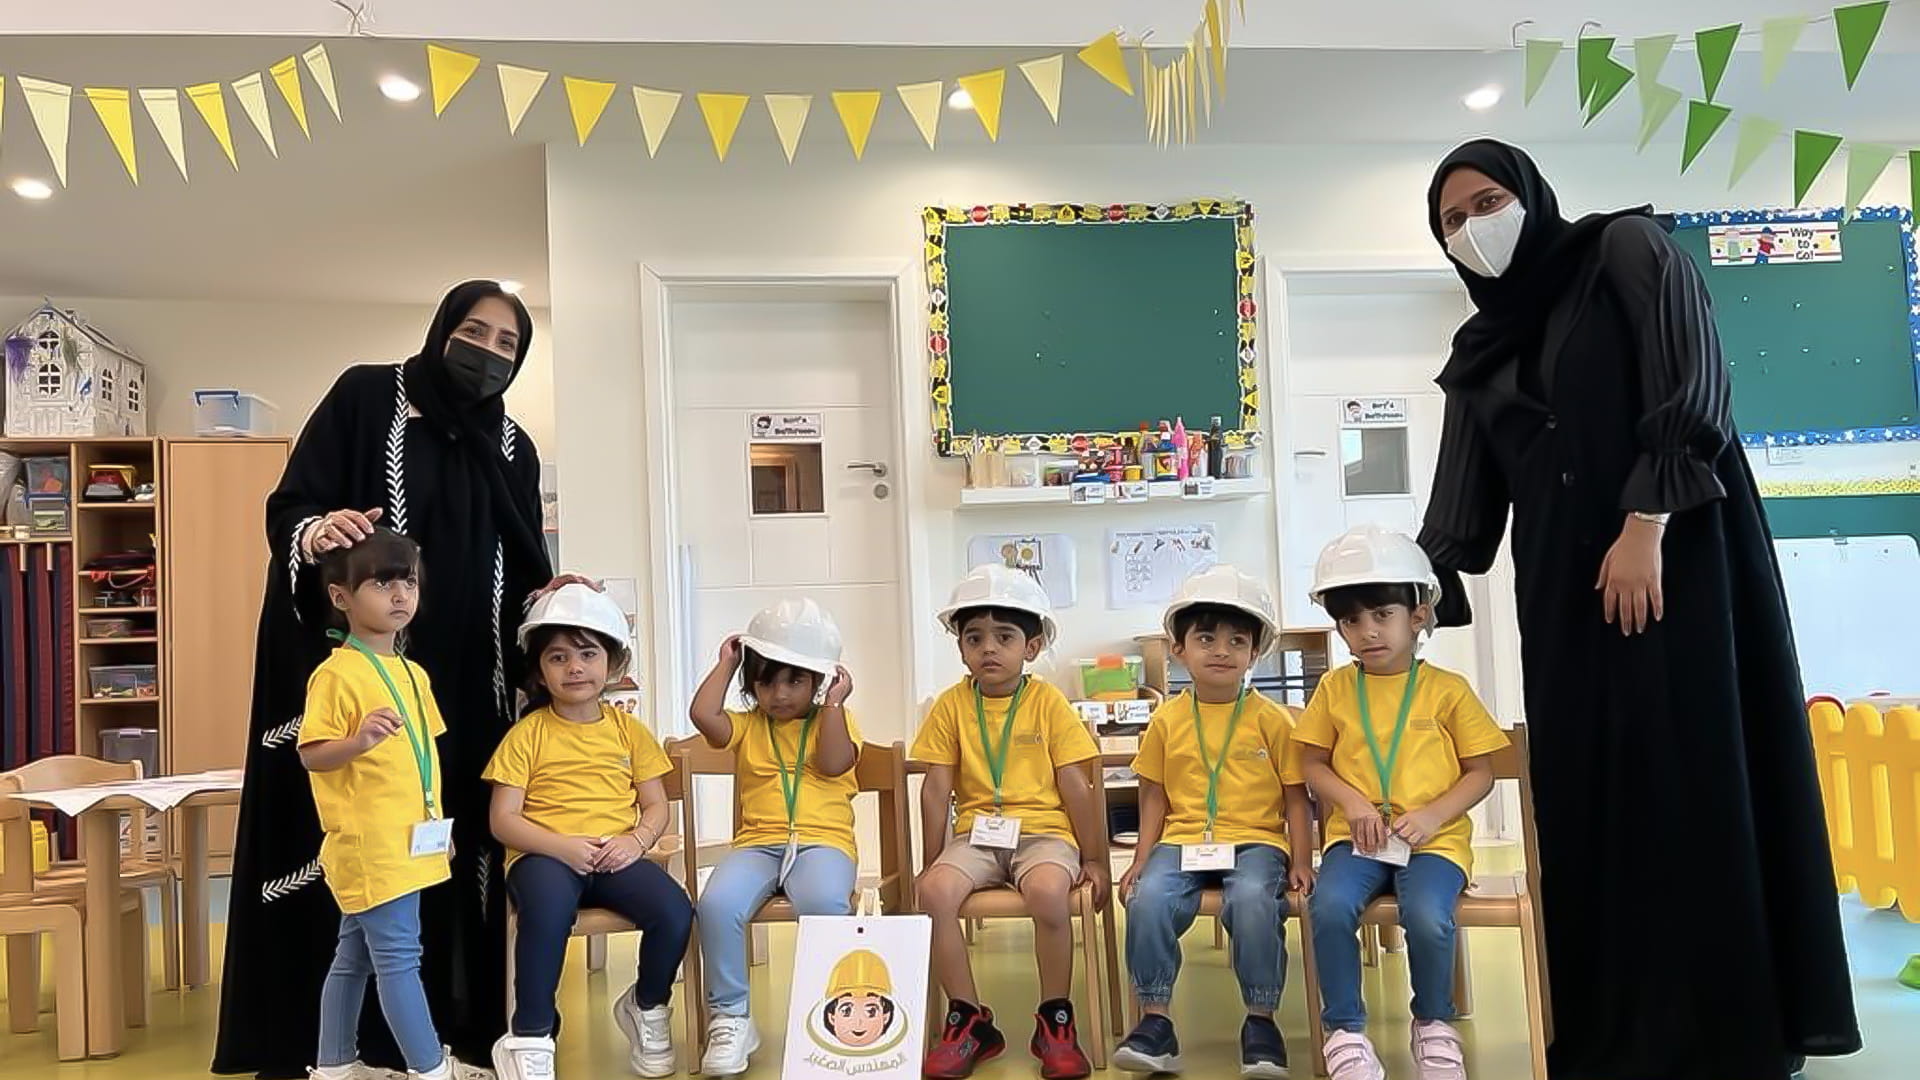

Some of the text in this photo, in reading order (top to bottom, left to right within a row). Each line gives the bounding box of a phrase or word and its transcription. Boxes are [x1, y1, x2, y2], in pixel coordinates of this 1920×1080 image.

[1790, 227, 1814, 240] Way
[1797, 239, 1810, 249] to
[1795, 250, 1814, 260] Go!
